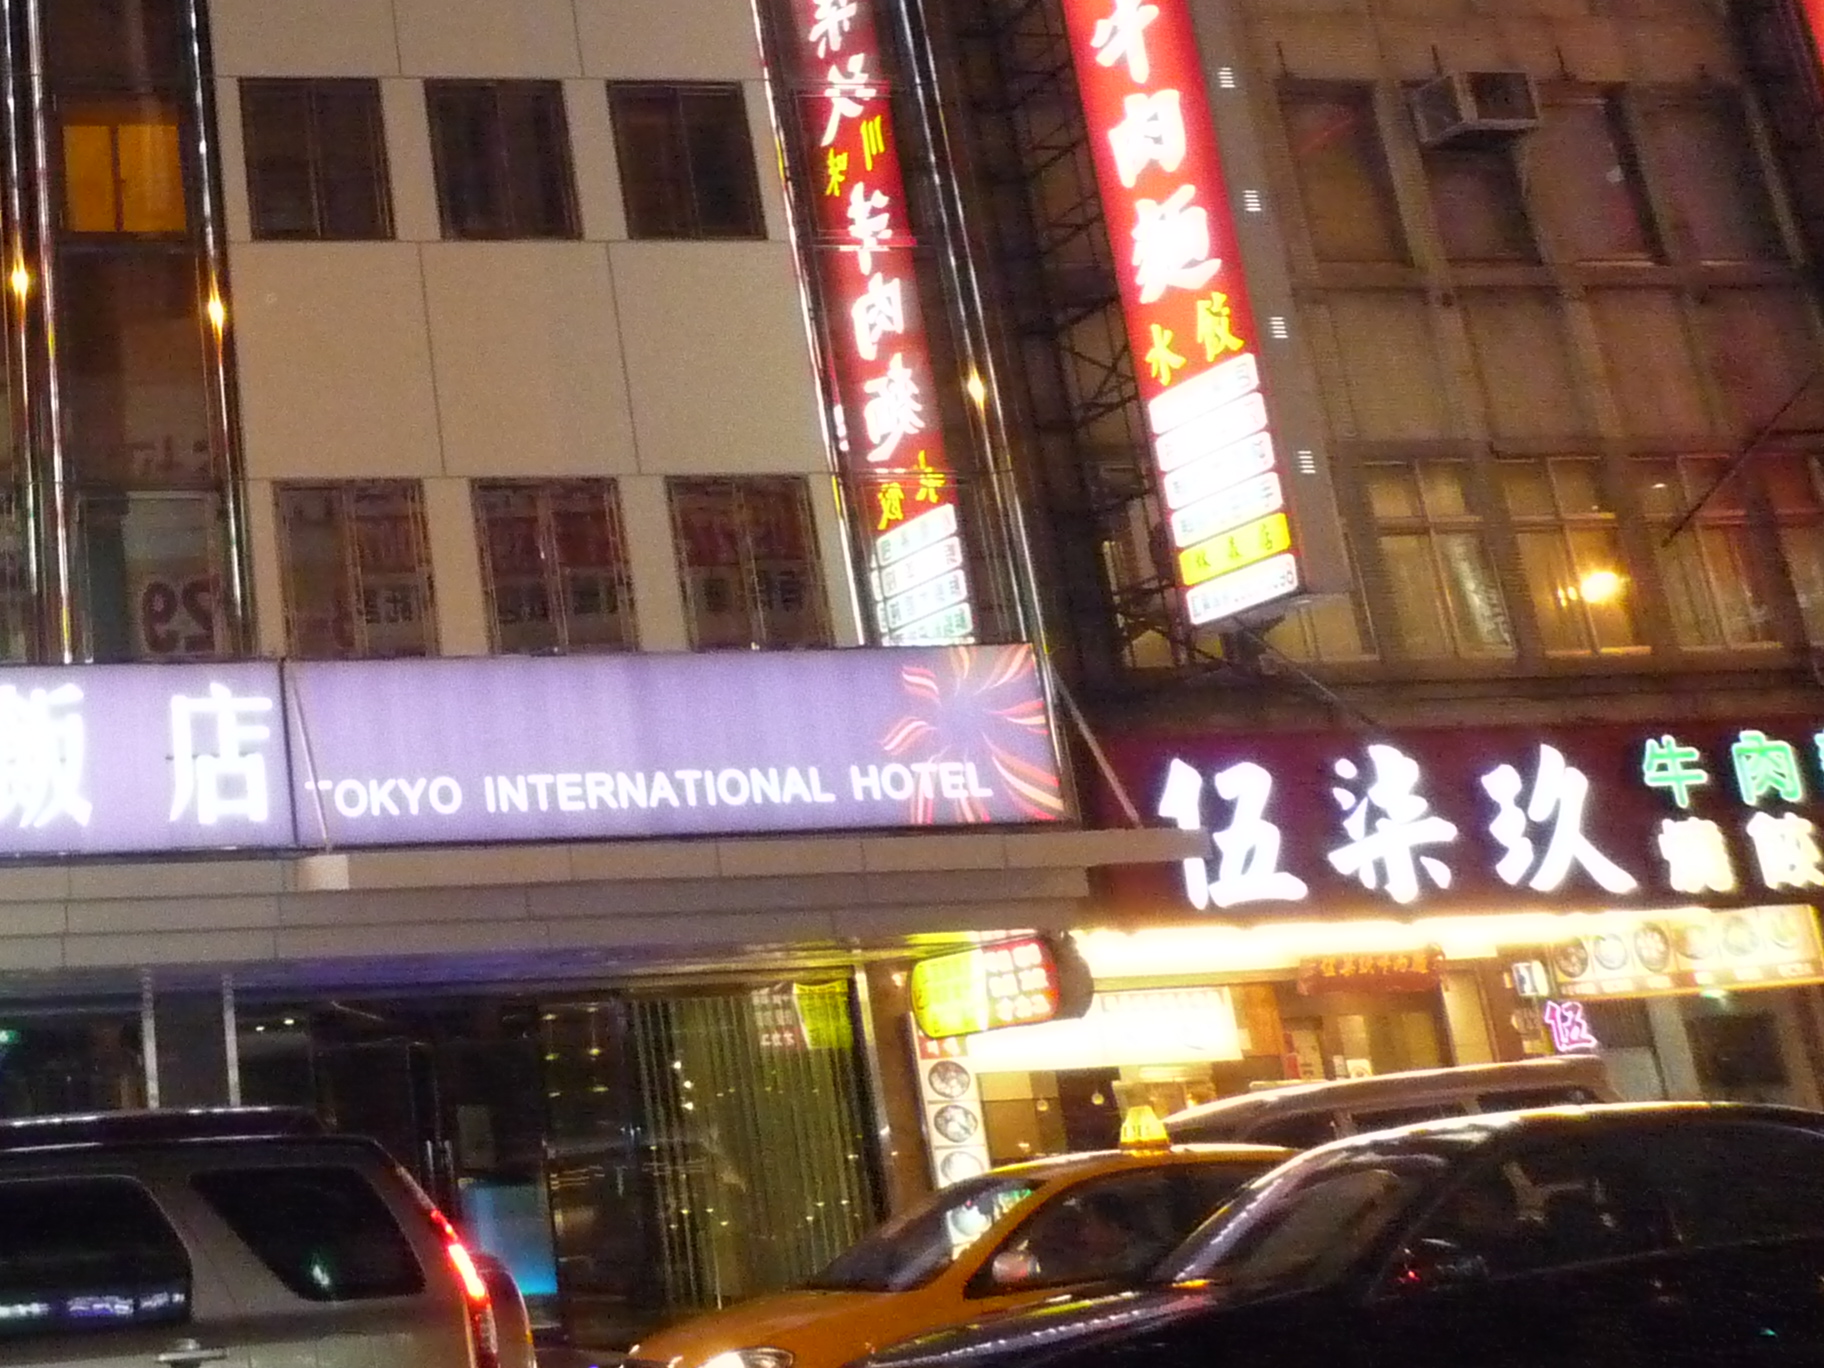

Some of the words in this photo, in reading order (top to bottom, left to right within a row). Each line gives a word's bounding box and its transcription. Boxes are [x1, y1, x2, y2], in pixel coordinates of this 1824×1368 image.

[485, 766, 836, 813] INTERNATIONAL
[850, 761, 994, 802] HOTEL
[1642, 729, 1824, 809] 牛肉
